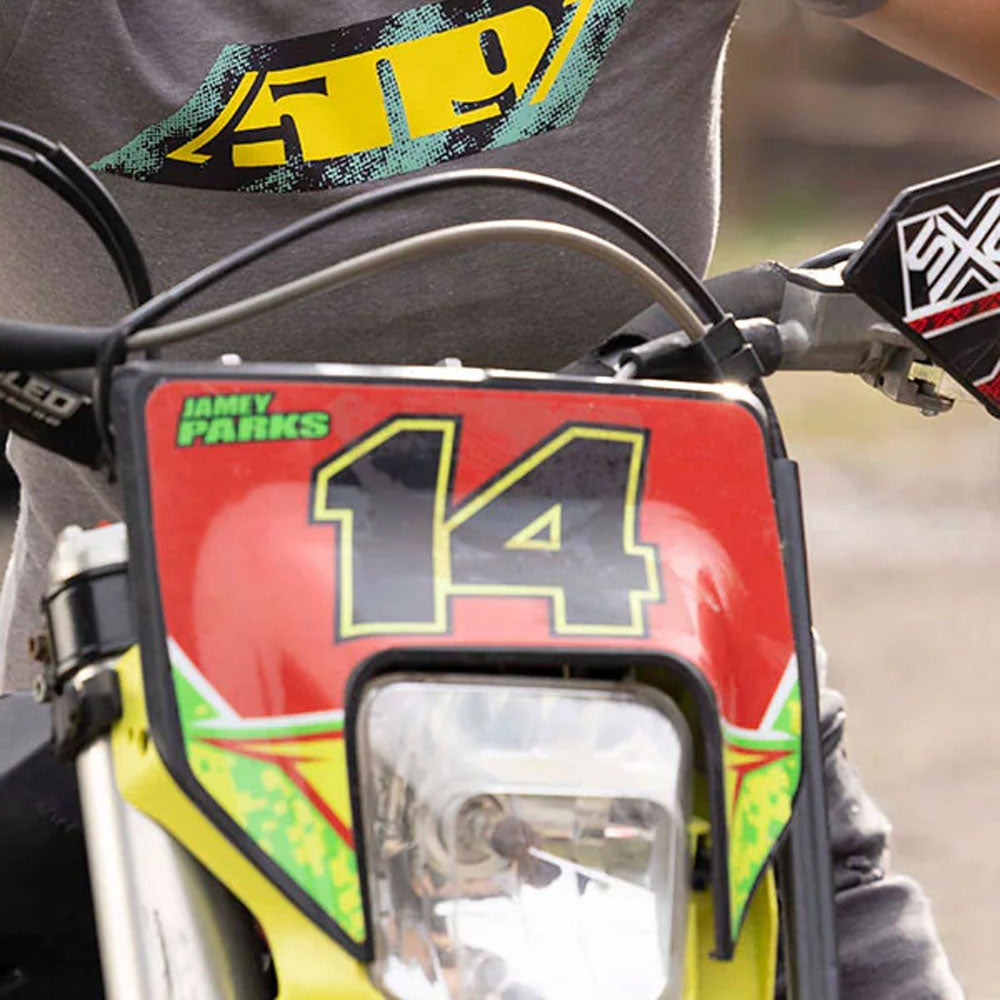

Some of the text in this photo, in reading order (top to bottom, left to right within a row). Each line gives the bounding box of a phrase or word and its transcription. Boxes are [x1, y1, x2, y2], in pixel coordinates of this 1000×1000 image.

[181, 391, 275, 418] JAMEY
[176, 411, 332, 447] PARKS
[309, 414, 664, 643] 14
